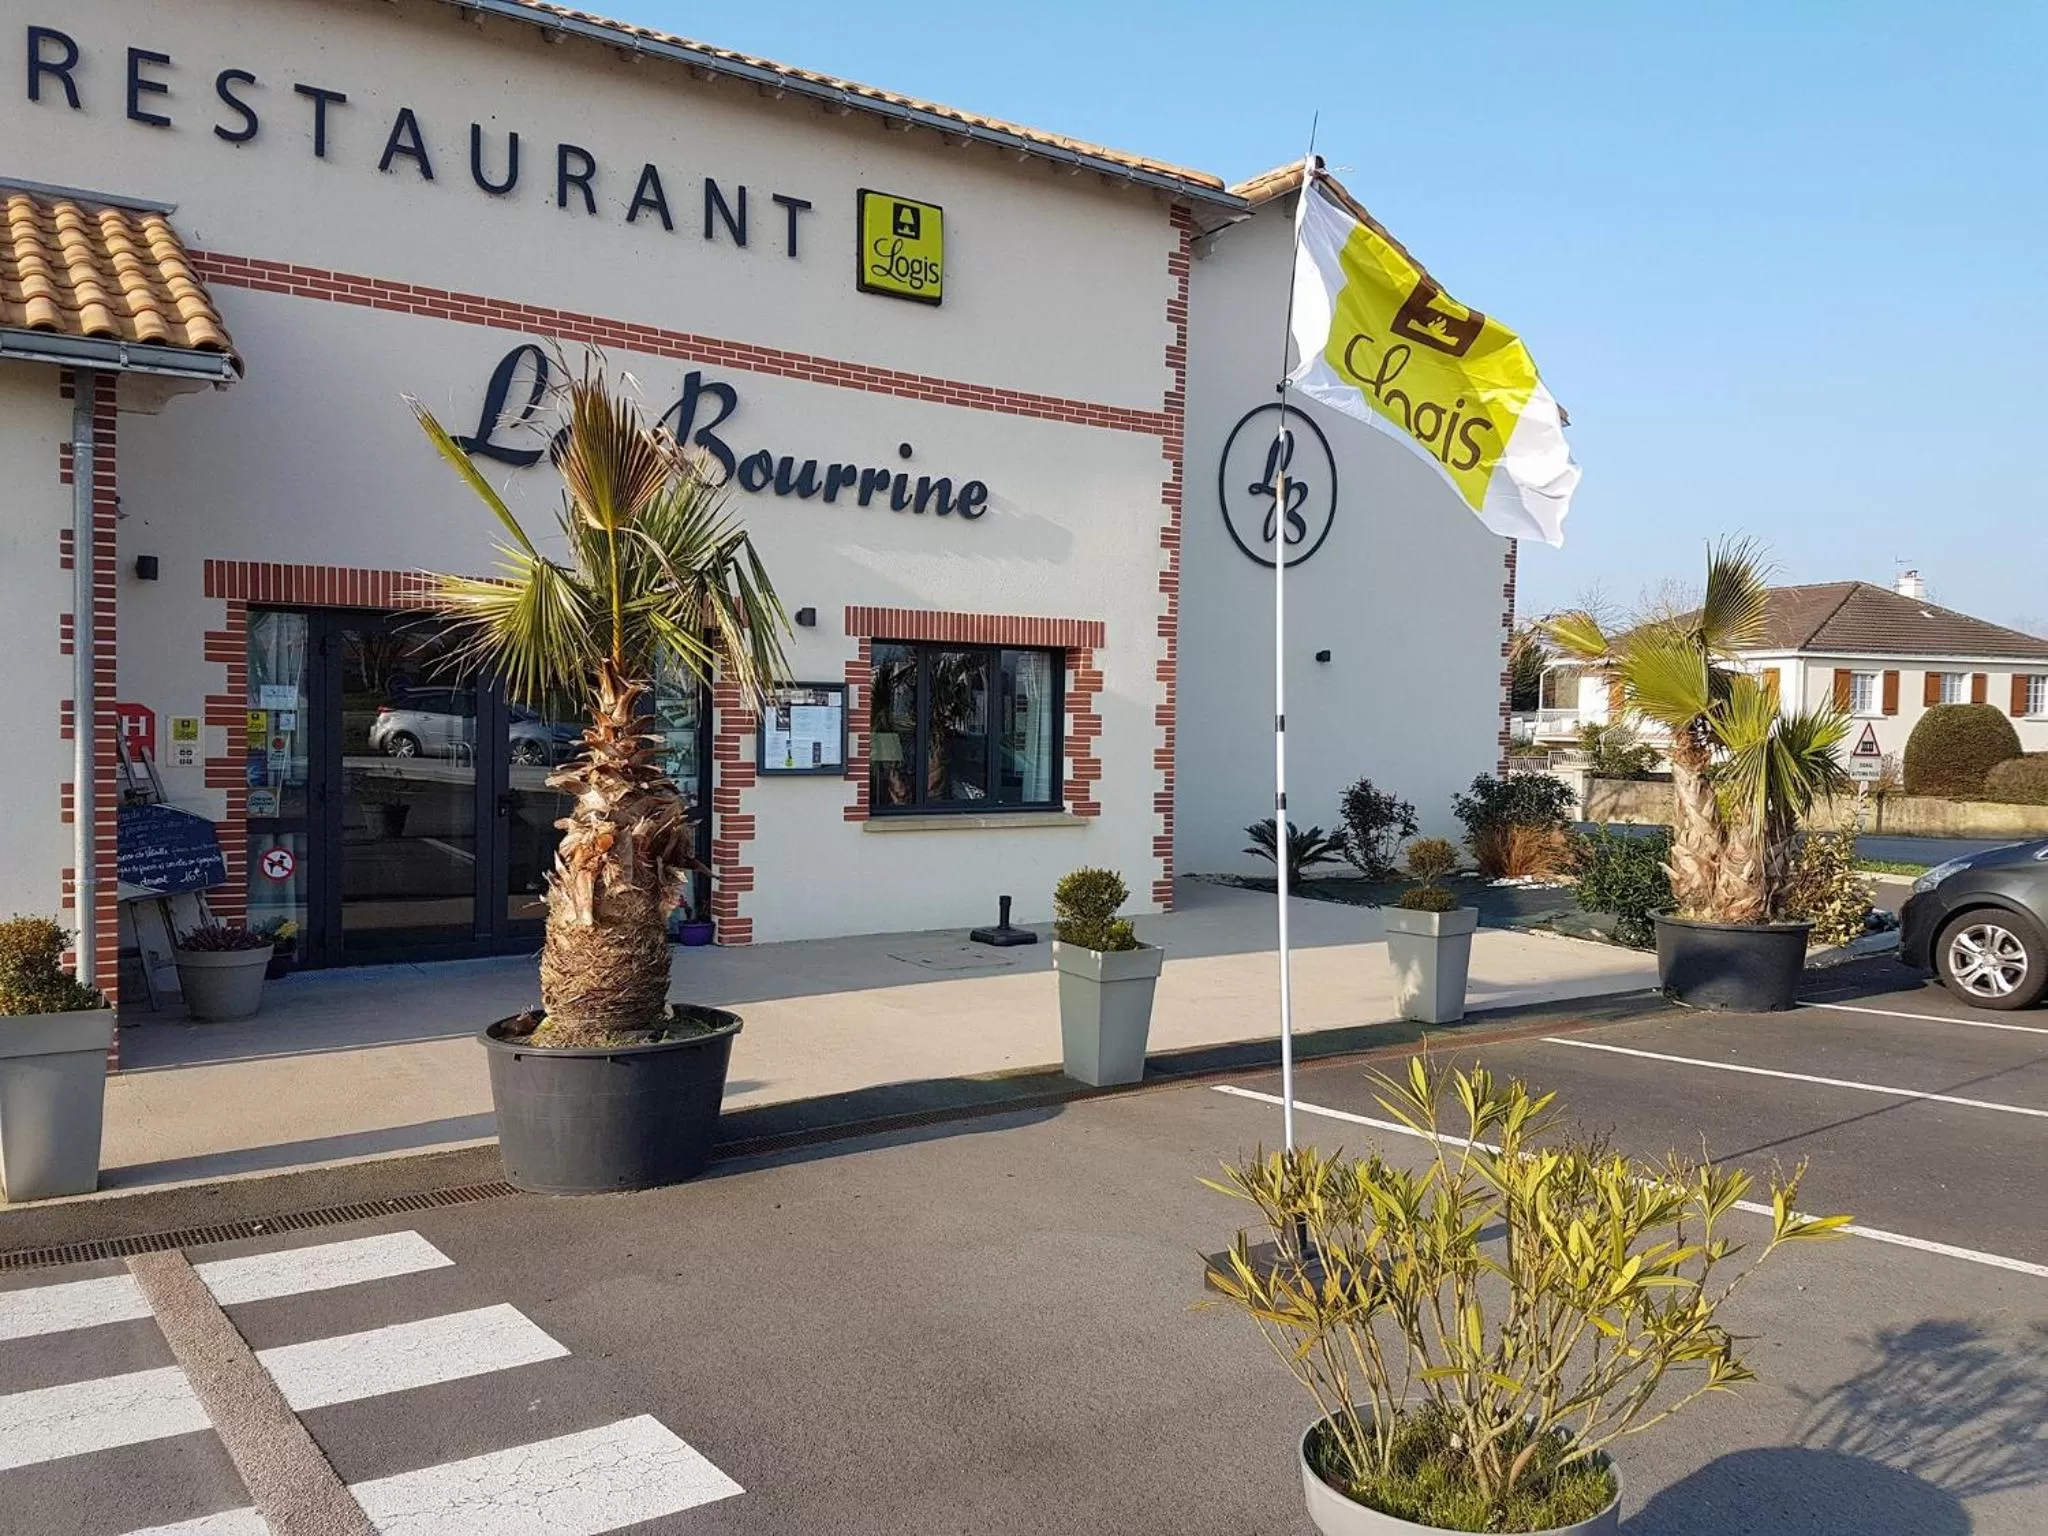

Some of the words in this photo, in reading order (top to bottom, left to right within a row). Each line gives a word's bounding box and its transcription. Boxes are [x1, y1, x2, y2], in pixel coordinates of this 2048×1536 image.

[27, 25, 812, 258] RESTAURANT
[871, 238, 940, 290] Logis
[449, 343, 575, 468] L
[651, 371, 989, 520] Bourrine
[122, 715, 147, 736] H
